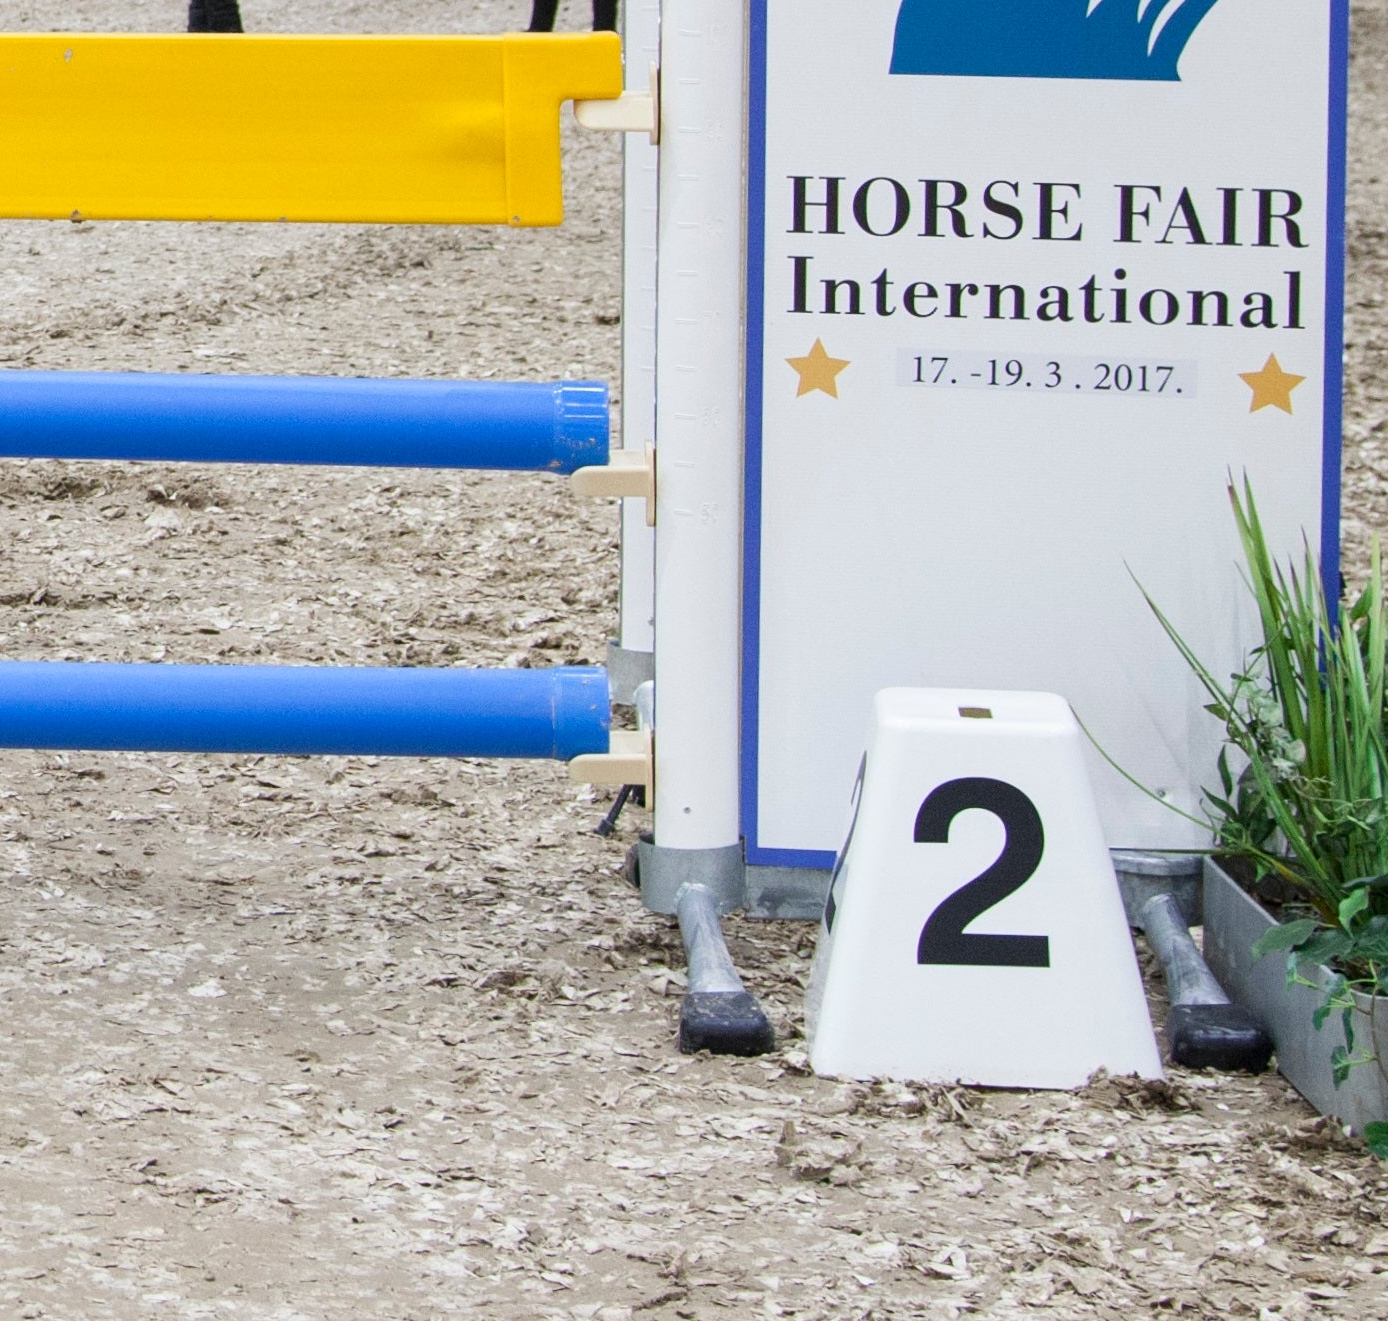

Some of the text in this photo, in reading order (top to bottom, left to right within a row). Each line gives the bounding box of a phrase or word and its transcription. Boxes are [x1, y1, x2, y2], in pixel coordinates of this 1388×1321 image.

[786, 176, 1308, 248] HORSE FAIR
[787, 256, 1305, 329] International
[914, 778, 1049, 967] 2
